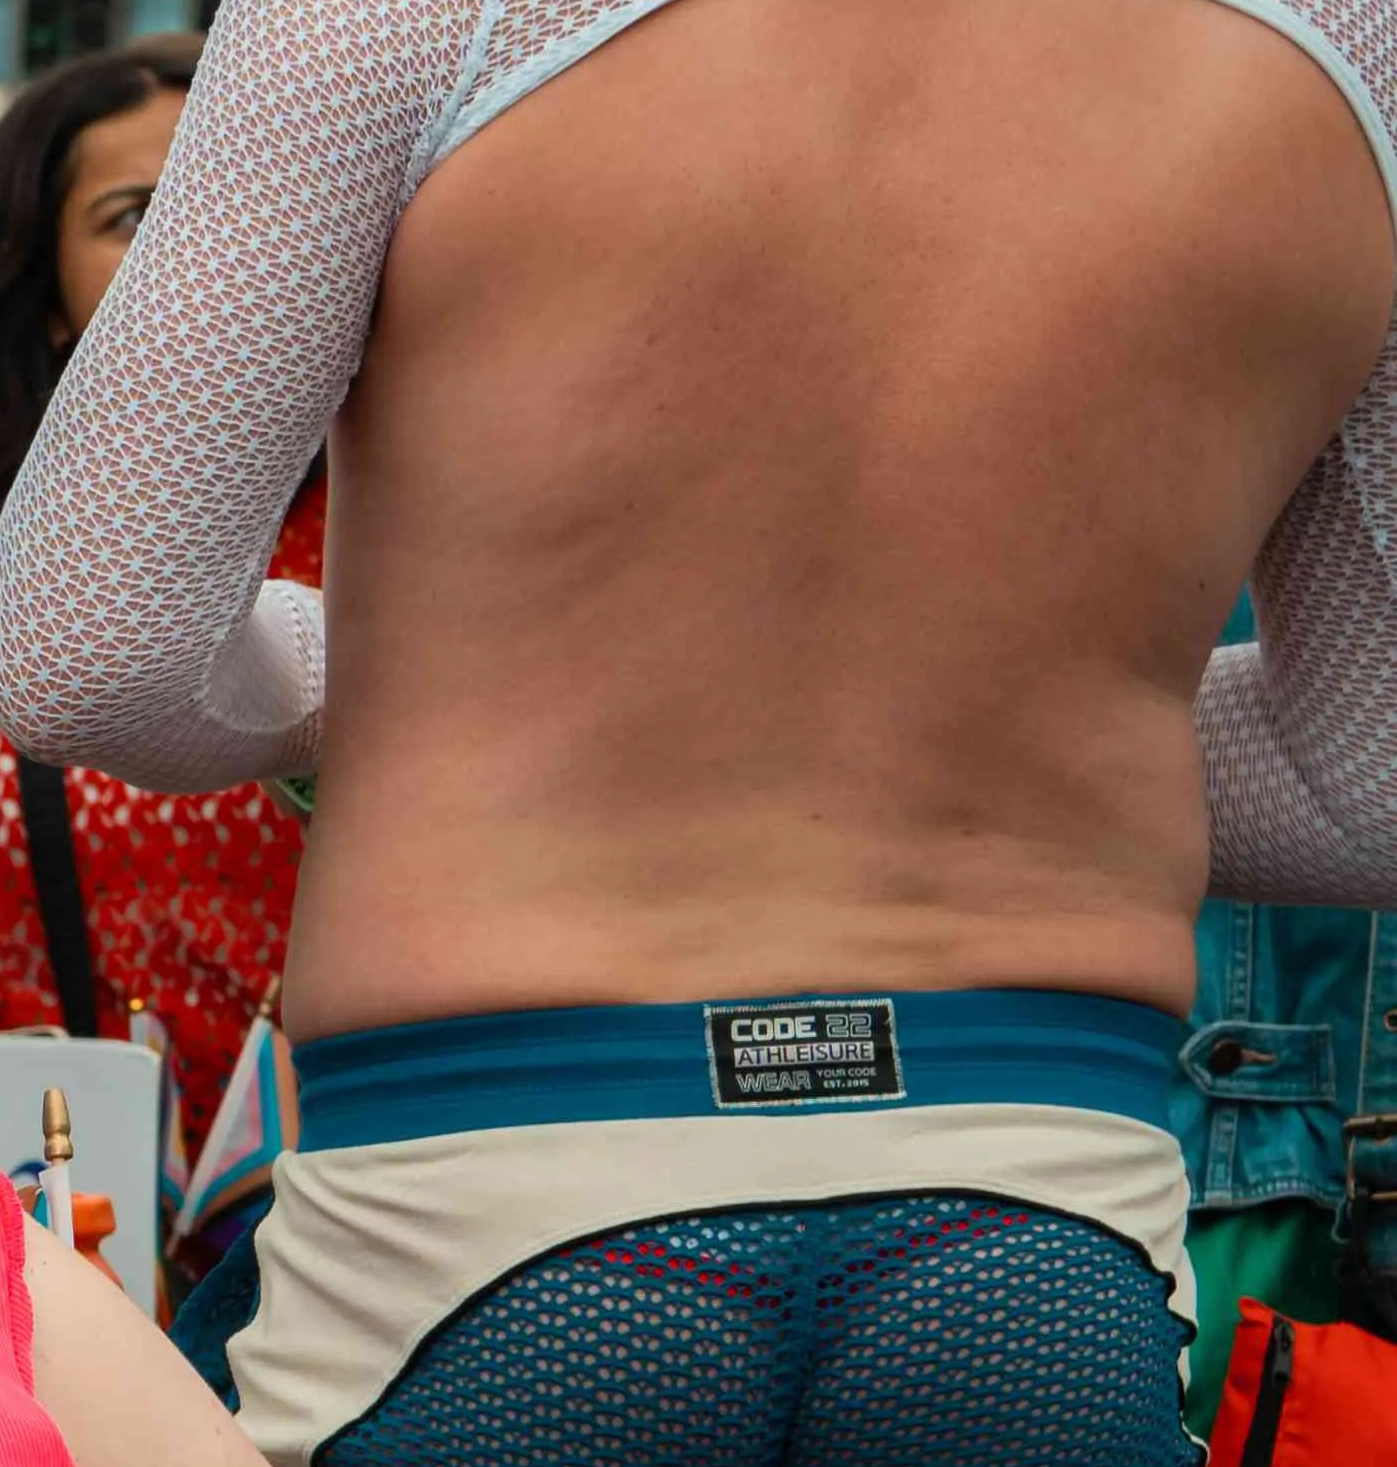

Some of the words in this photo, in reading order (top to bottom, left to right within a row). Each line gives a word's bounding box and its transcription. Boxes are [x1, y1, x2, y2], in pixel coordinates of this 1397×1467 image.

[731, 1016, 817, 1042] CODE
[825, 1013, 872, 1038] 22
[737, 1043, 872, 1066] ATHLEISURE
[735, 1069, 812, 1093] WEAR
